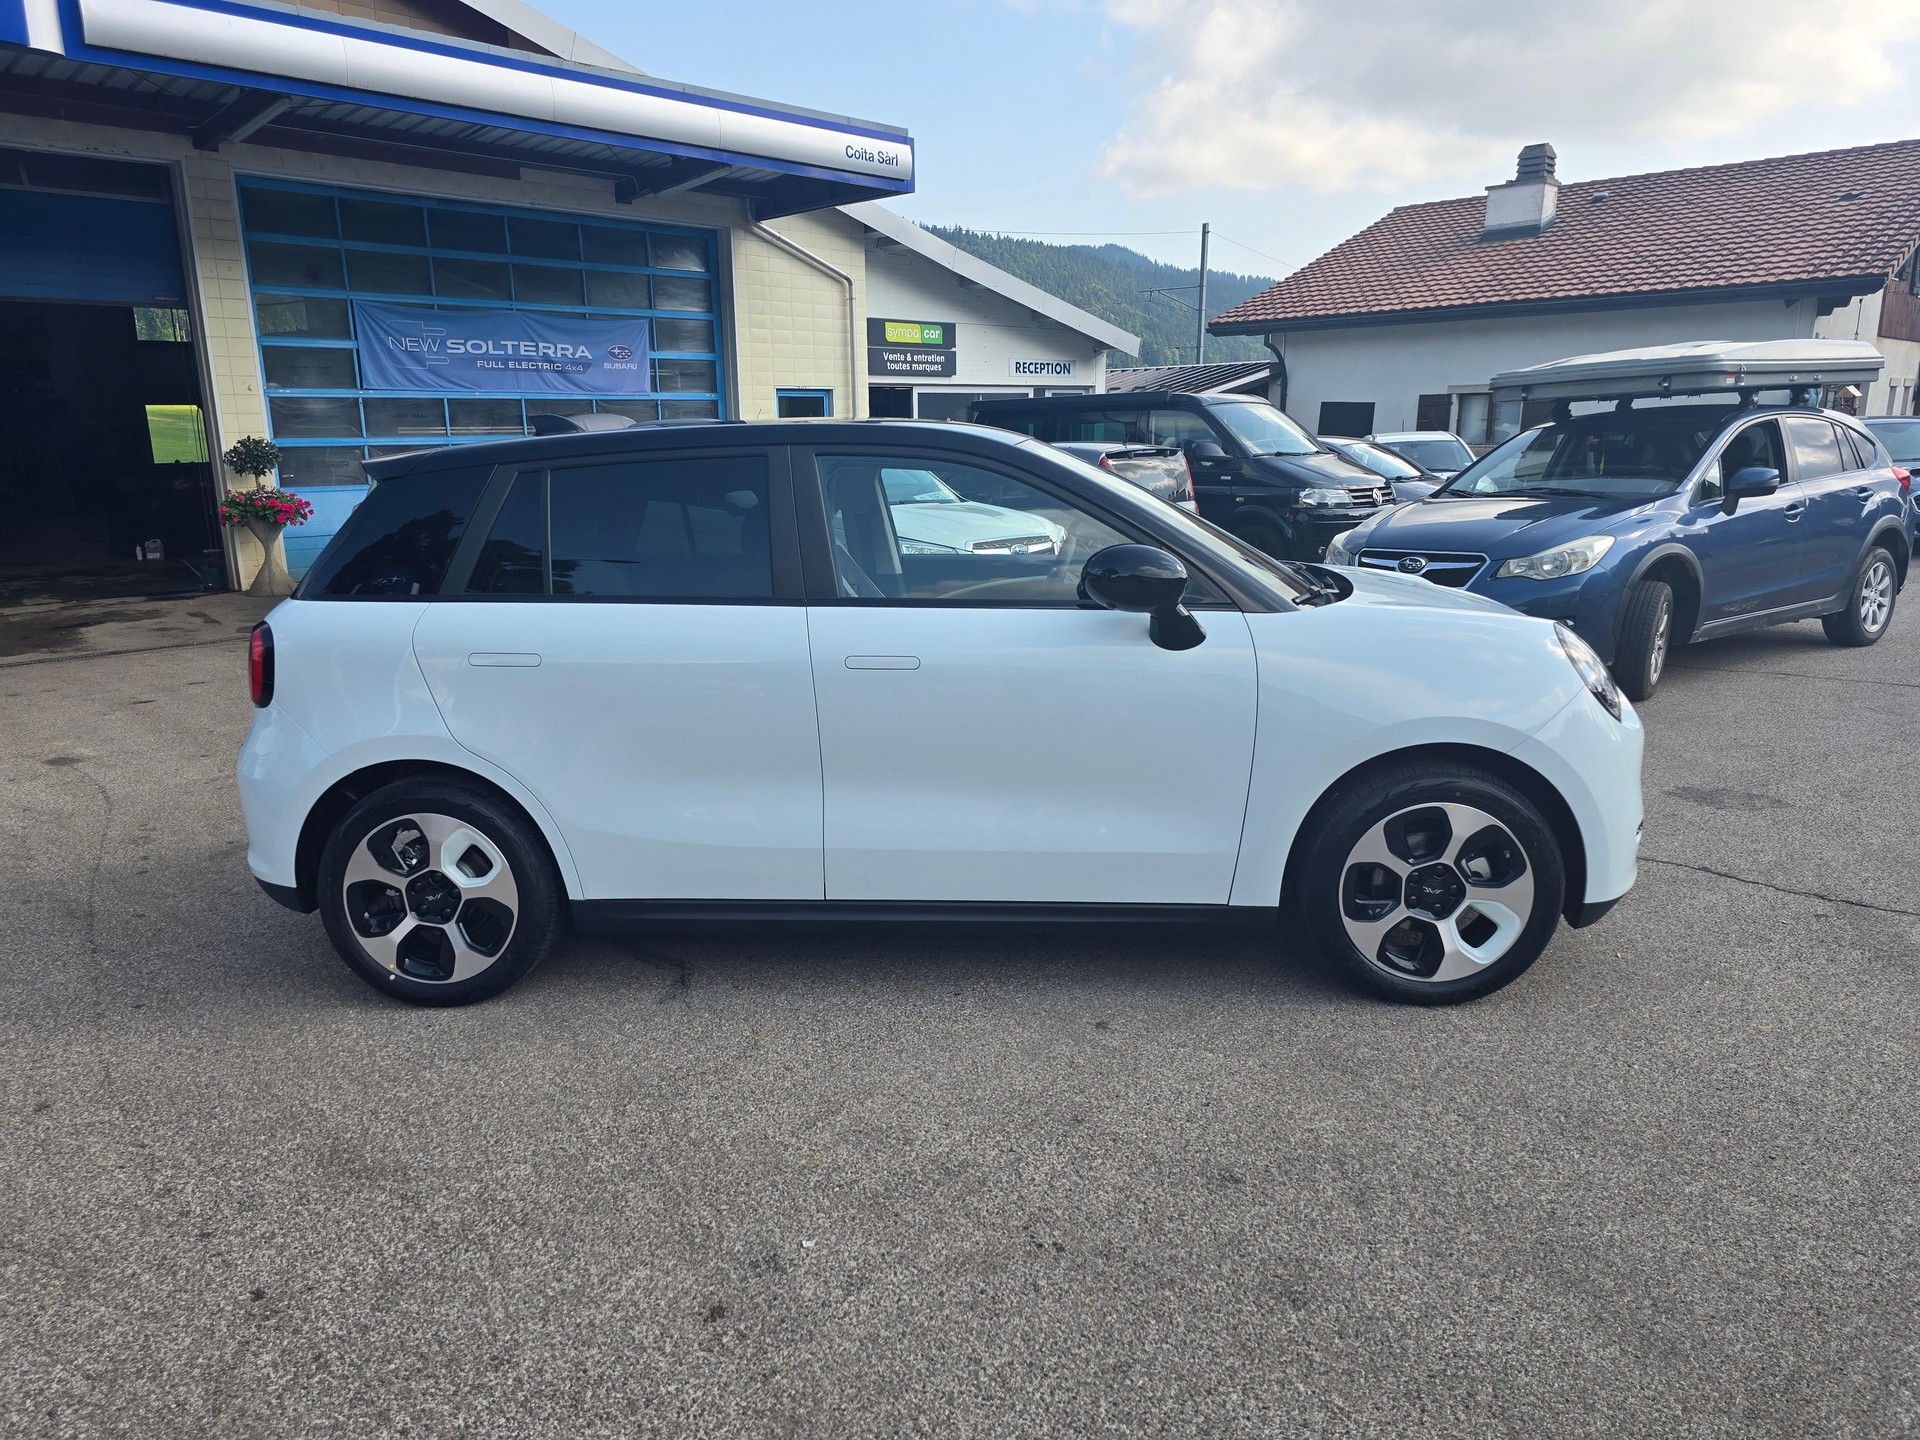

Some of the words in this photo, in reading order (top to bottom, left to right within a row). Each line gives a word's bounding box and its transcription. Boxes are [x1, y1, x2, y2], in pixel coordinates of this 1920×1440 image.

[845, 145, 875, 163] Coita
[877, 150, 899, 167] Sàrl
[887, 327, 920, 340] sympa
[923, 329, 941, 339] car
[388, 335, 441, 353] NEW
[446, 339, 593, 360] SOLTERRA
[883, 352, 905, 361] Vente
[906, 353, 912, 361] &
[913, 354, 945, 362] entretien
[477, 360, 505, 369] FULL
[509, 362, 562, 371] ELECTRIC
[565, 364, 584, 372] 4x4
[603, 362, 638, 370] SUBARU
[887, 361, 910, 370] toutes
[912, 362, 942, 372] marques
[1015, 361, 1071, 375] RECEPTION
